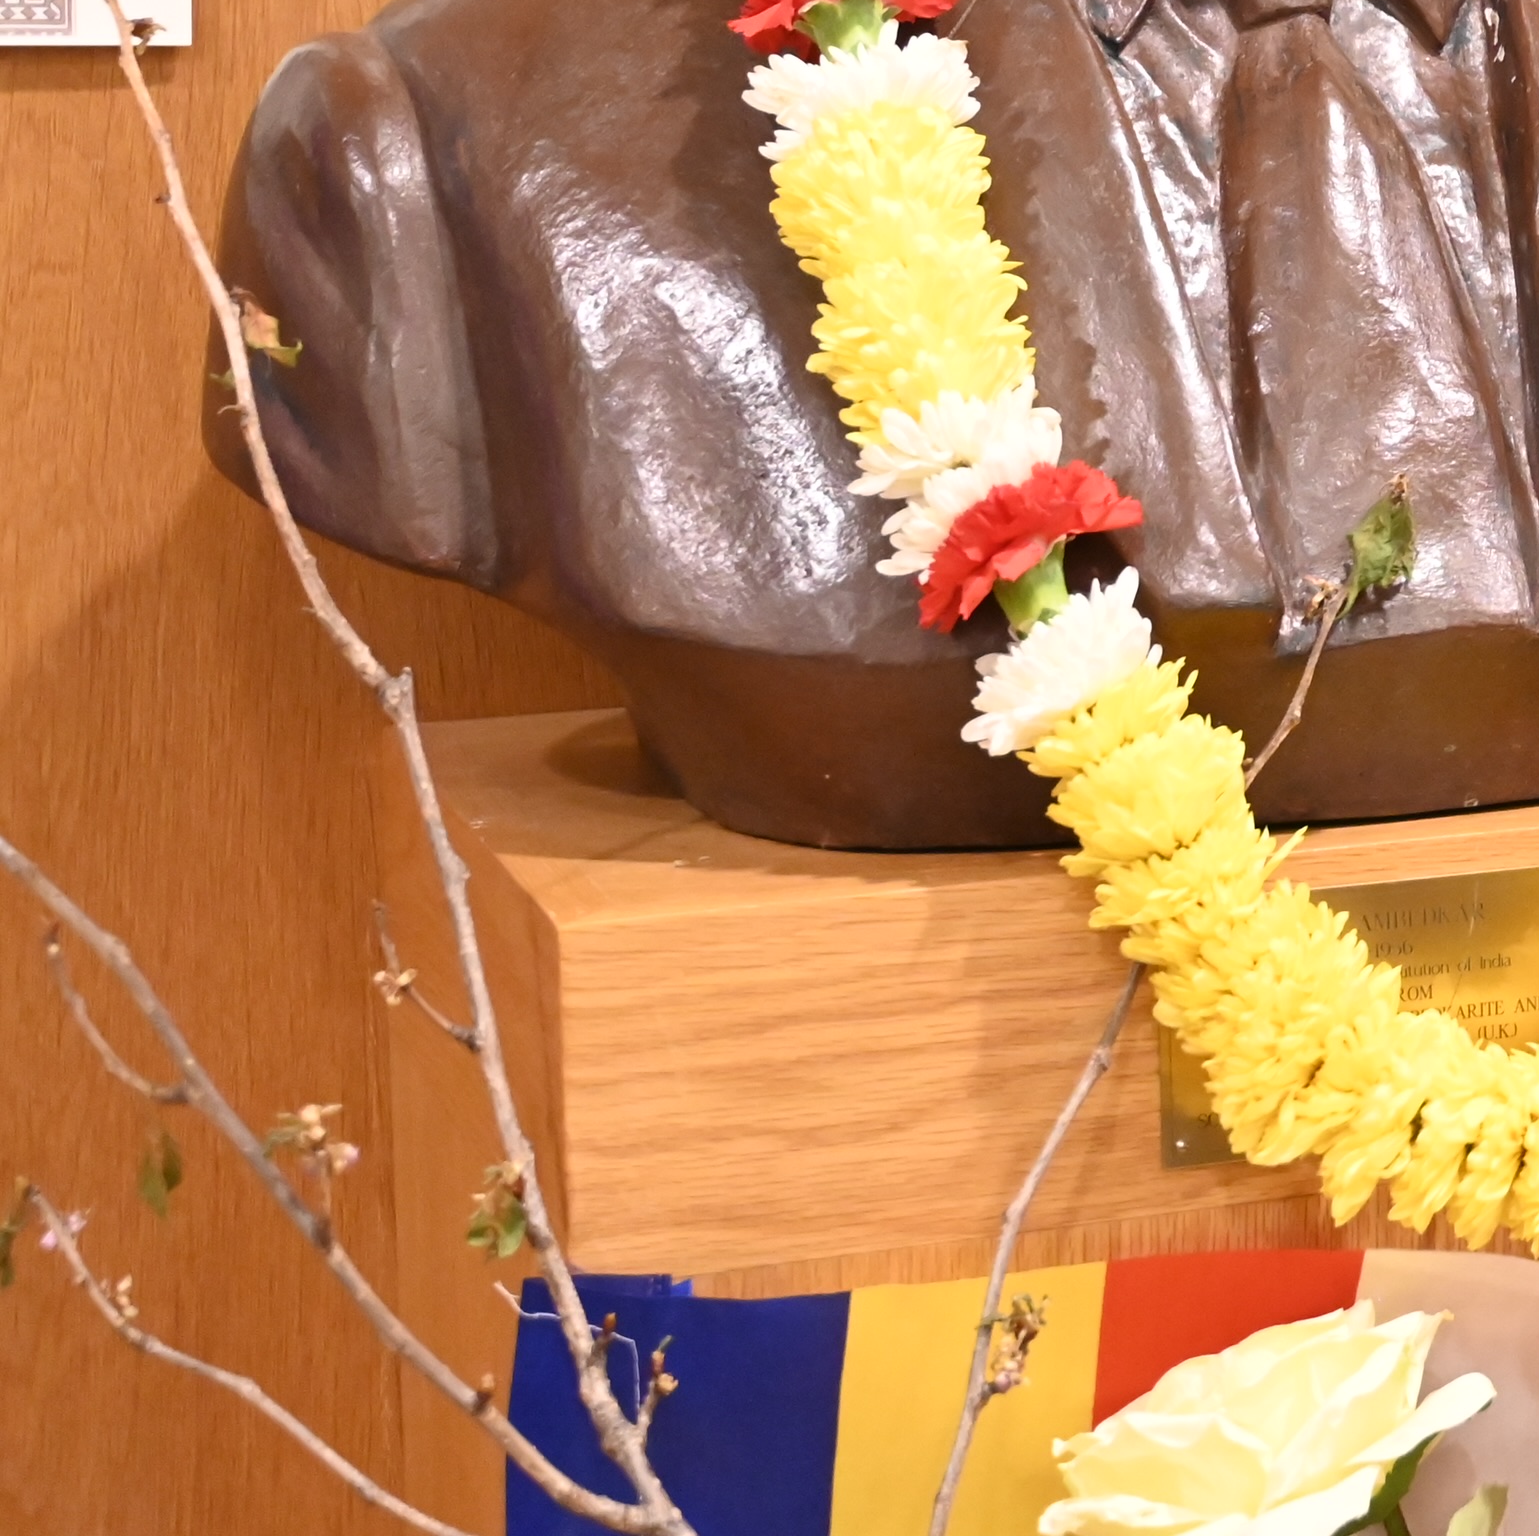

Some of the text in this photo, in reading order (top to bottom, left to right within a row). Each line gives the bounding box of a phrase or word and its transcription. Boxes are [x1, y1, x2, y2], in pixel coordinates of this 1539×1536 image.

[1360, 902, 1486, 932] AMBEDKAR
[1400, 954, 1512, 979] itution of India
[1400, 984, 1433, 1002] ROM
